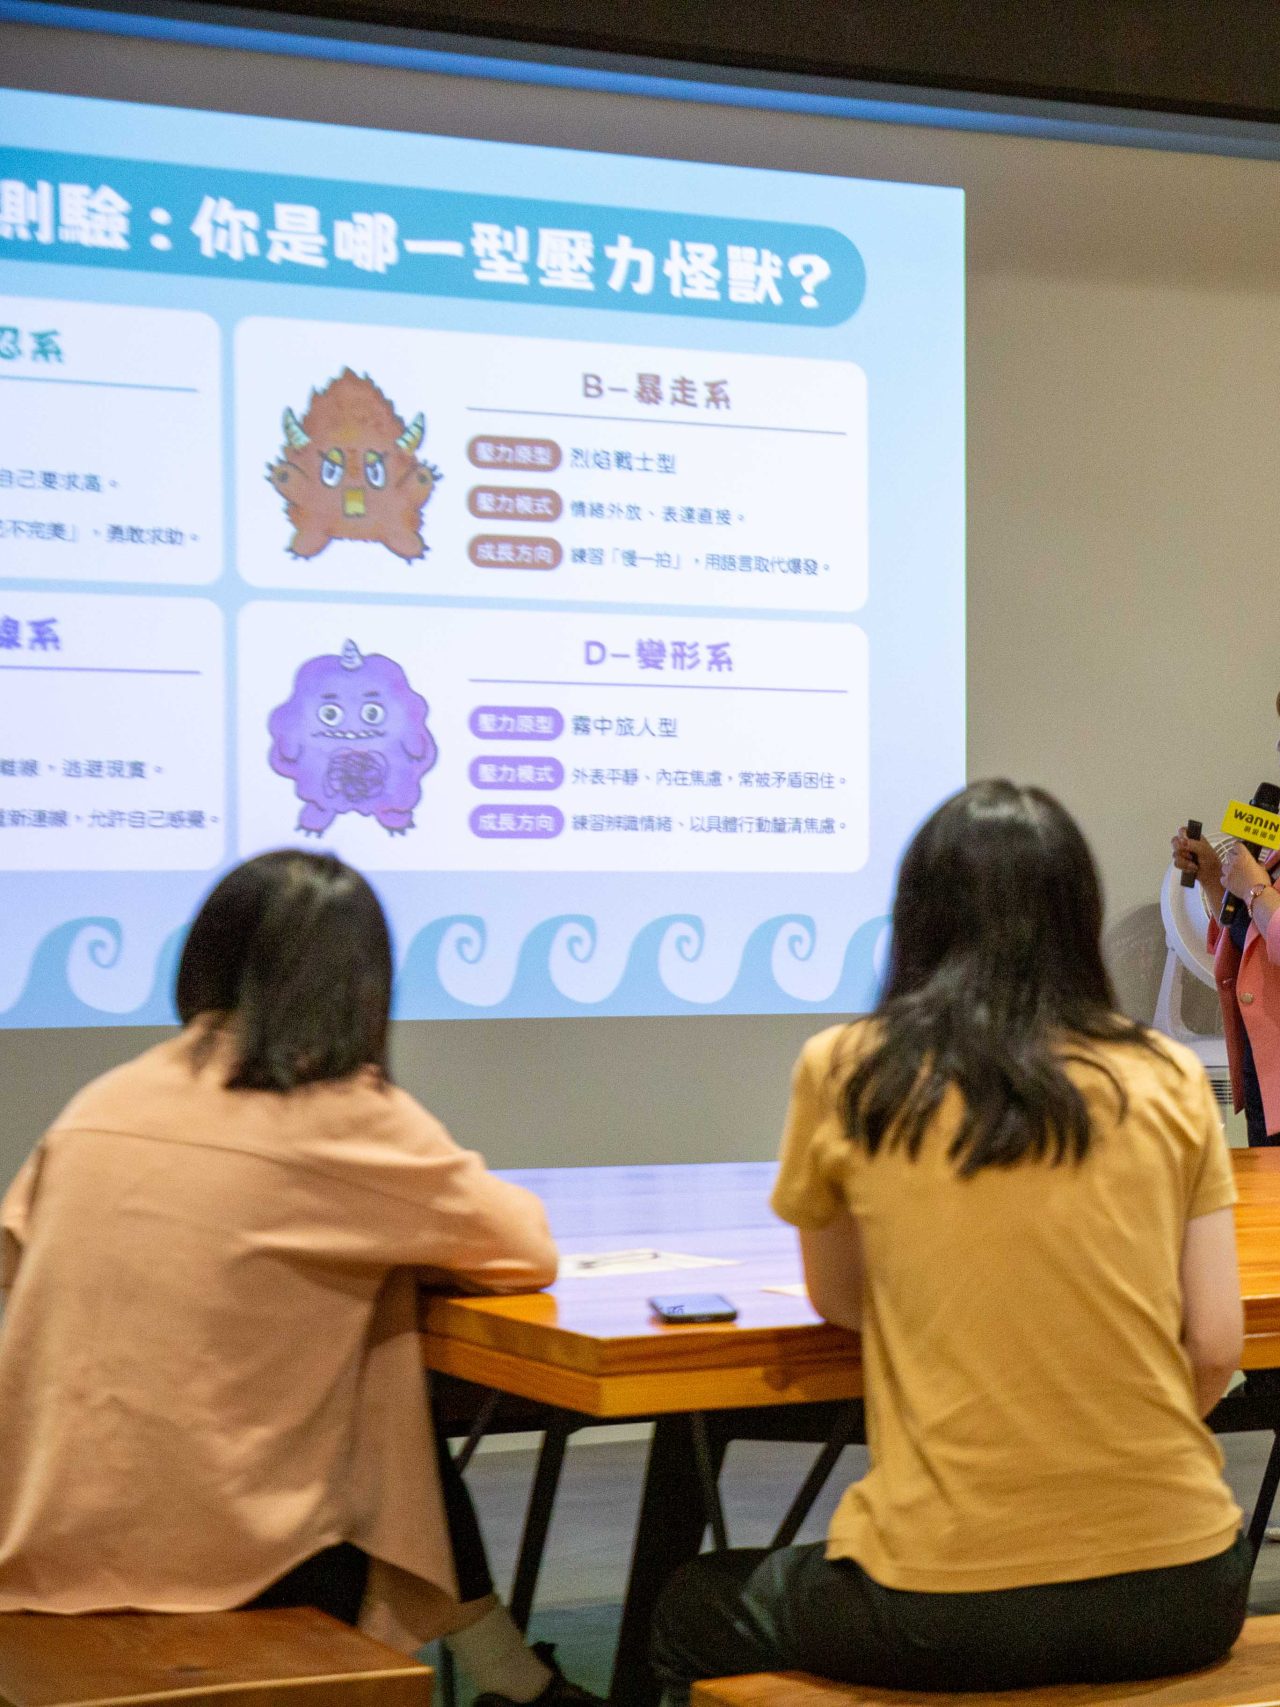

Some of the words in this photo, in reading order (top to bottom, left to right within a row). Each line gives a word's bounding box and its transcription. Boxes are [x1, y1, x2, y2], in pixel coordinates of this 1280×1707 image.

[476, 542, 554, 565] 成長方向
[478, 713, 554, 735] 壓力原型
[571, 715, 679, 738] 霧中旅人型
[478, 763, 554, 784] 壓力模式
[478, 813, 555, 833] 成長方向
